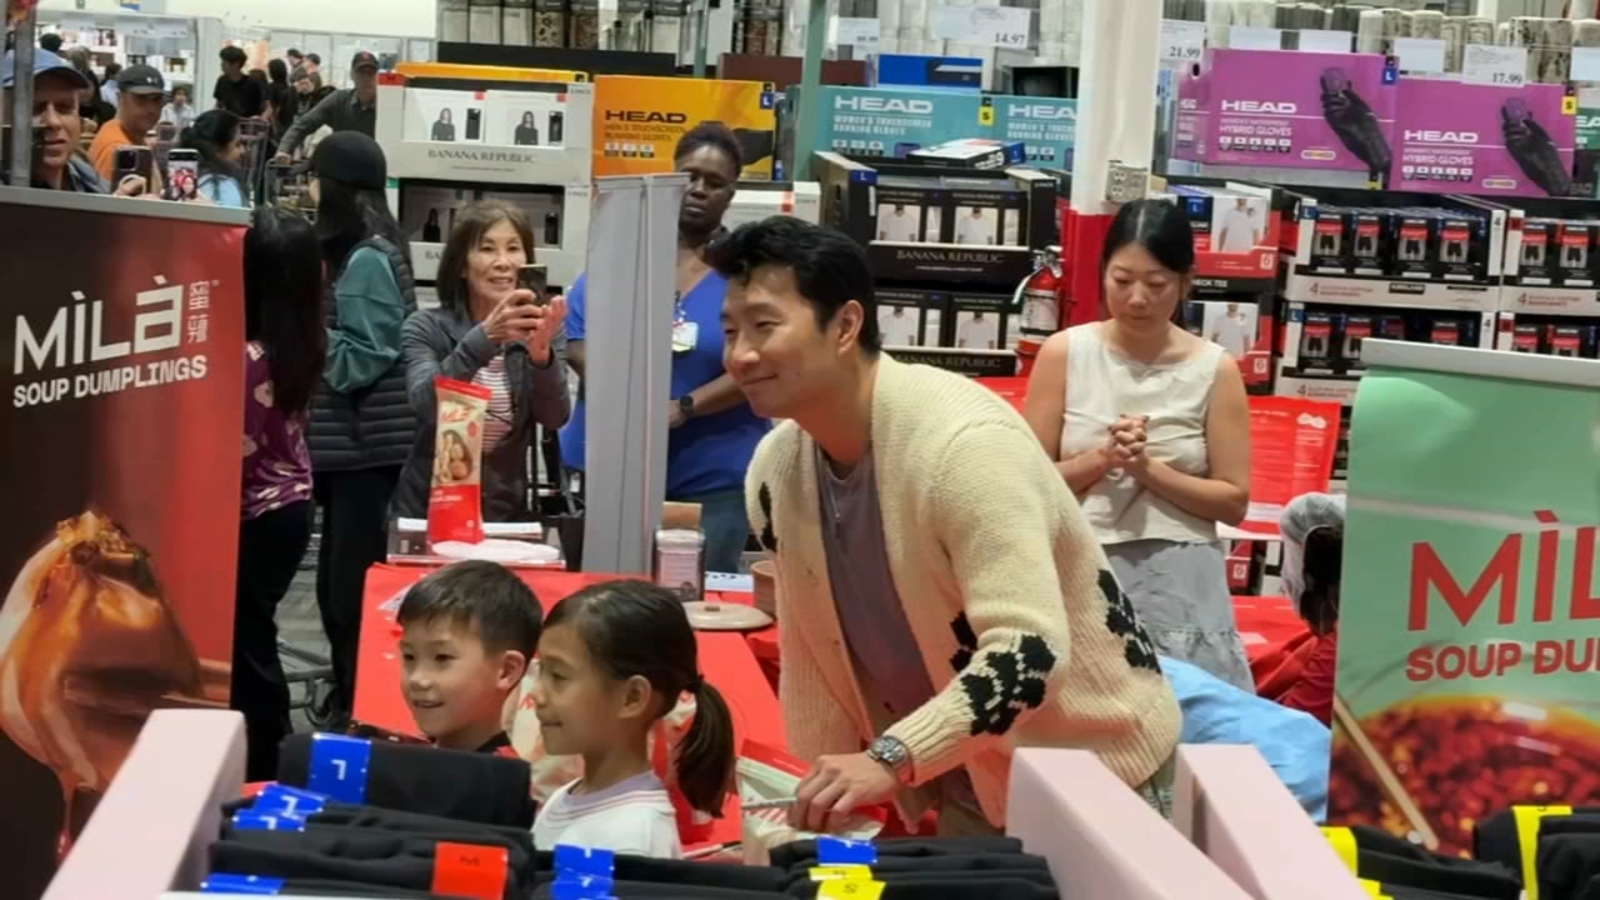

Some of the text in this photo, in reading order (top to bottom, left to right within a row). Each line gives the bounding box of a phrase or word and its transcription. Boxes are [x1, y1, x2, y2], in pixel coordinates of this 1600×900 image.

[994, 32, 1025, 45] 14.97
[1385, 69, 1393, 81] L
[1492, 72, 1523, 84] 17.99
[762, 94, 771, 106] L
[834, 95, 934, 114] HEAD
[1221, 99, 1297, 114] HEAD
[605, 109, 687, 124] HEAD
[1219, 125, 1293, 137] HYBRID GLOVES
[1403, 130, 1479, 144] HEAD
[428, 149, 535, 164] BANANA REPUBLIC
[1402, 154, 1474, 166] HYBRID GLOVES
[896, 249, 1004, 264] BANANA REPUBLIC
[13, 354, 208, 408] SOUP DUMPLINGS
[1405, 637, 1600, 682] SOUP DU
